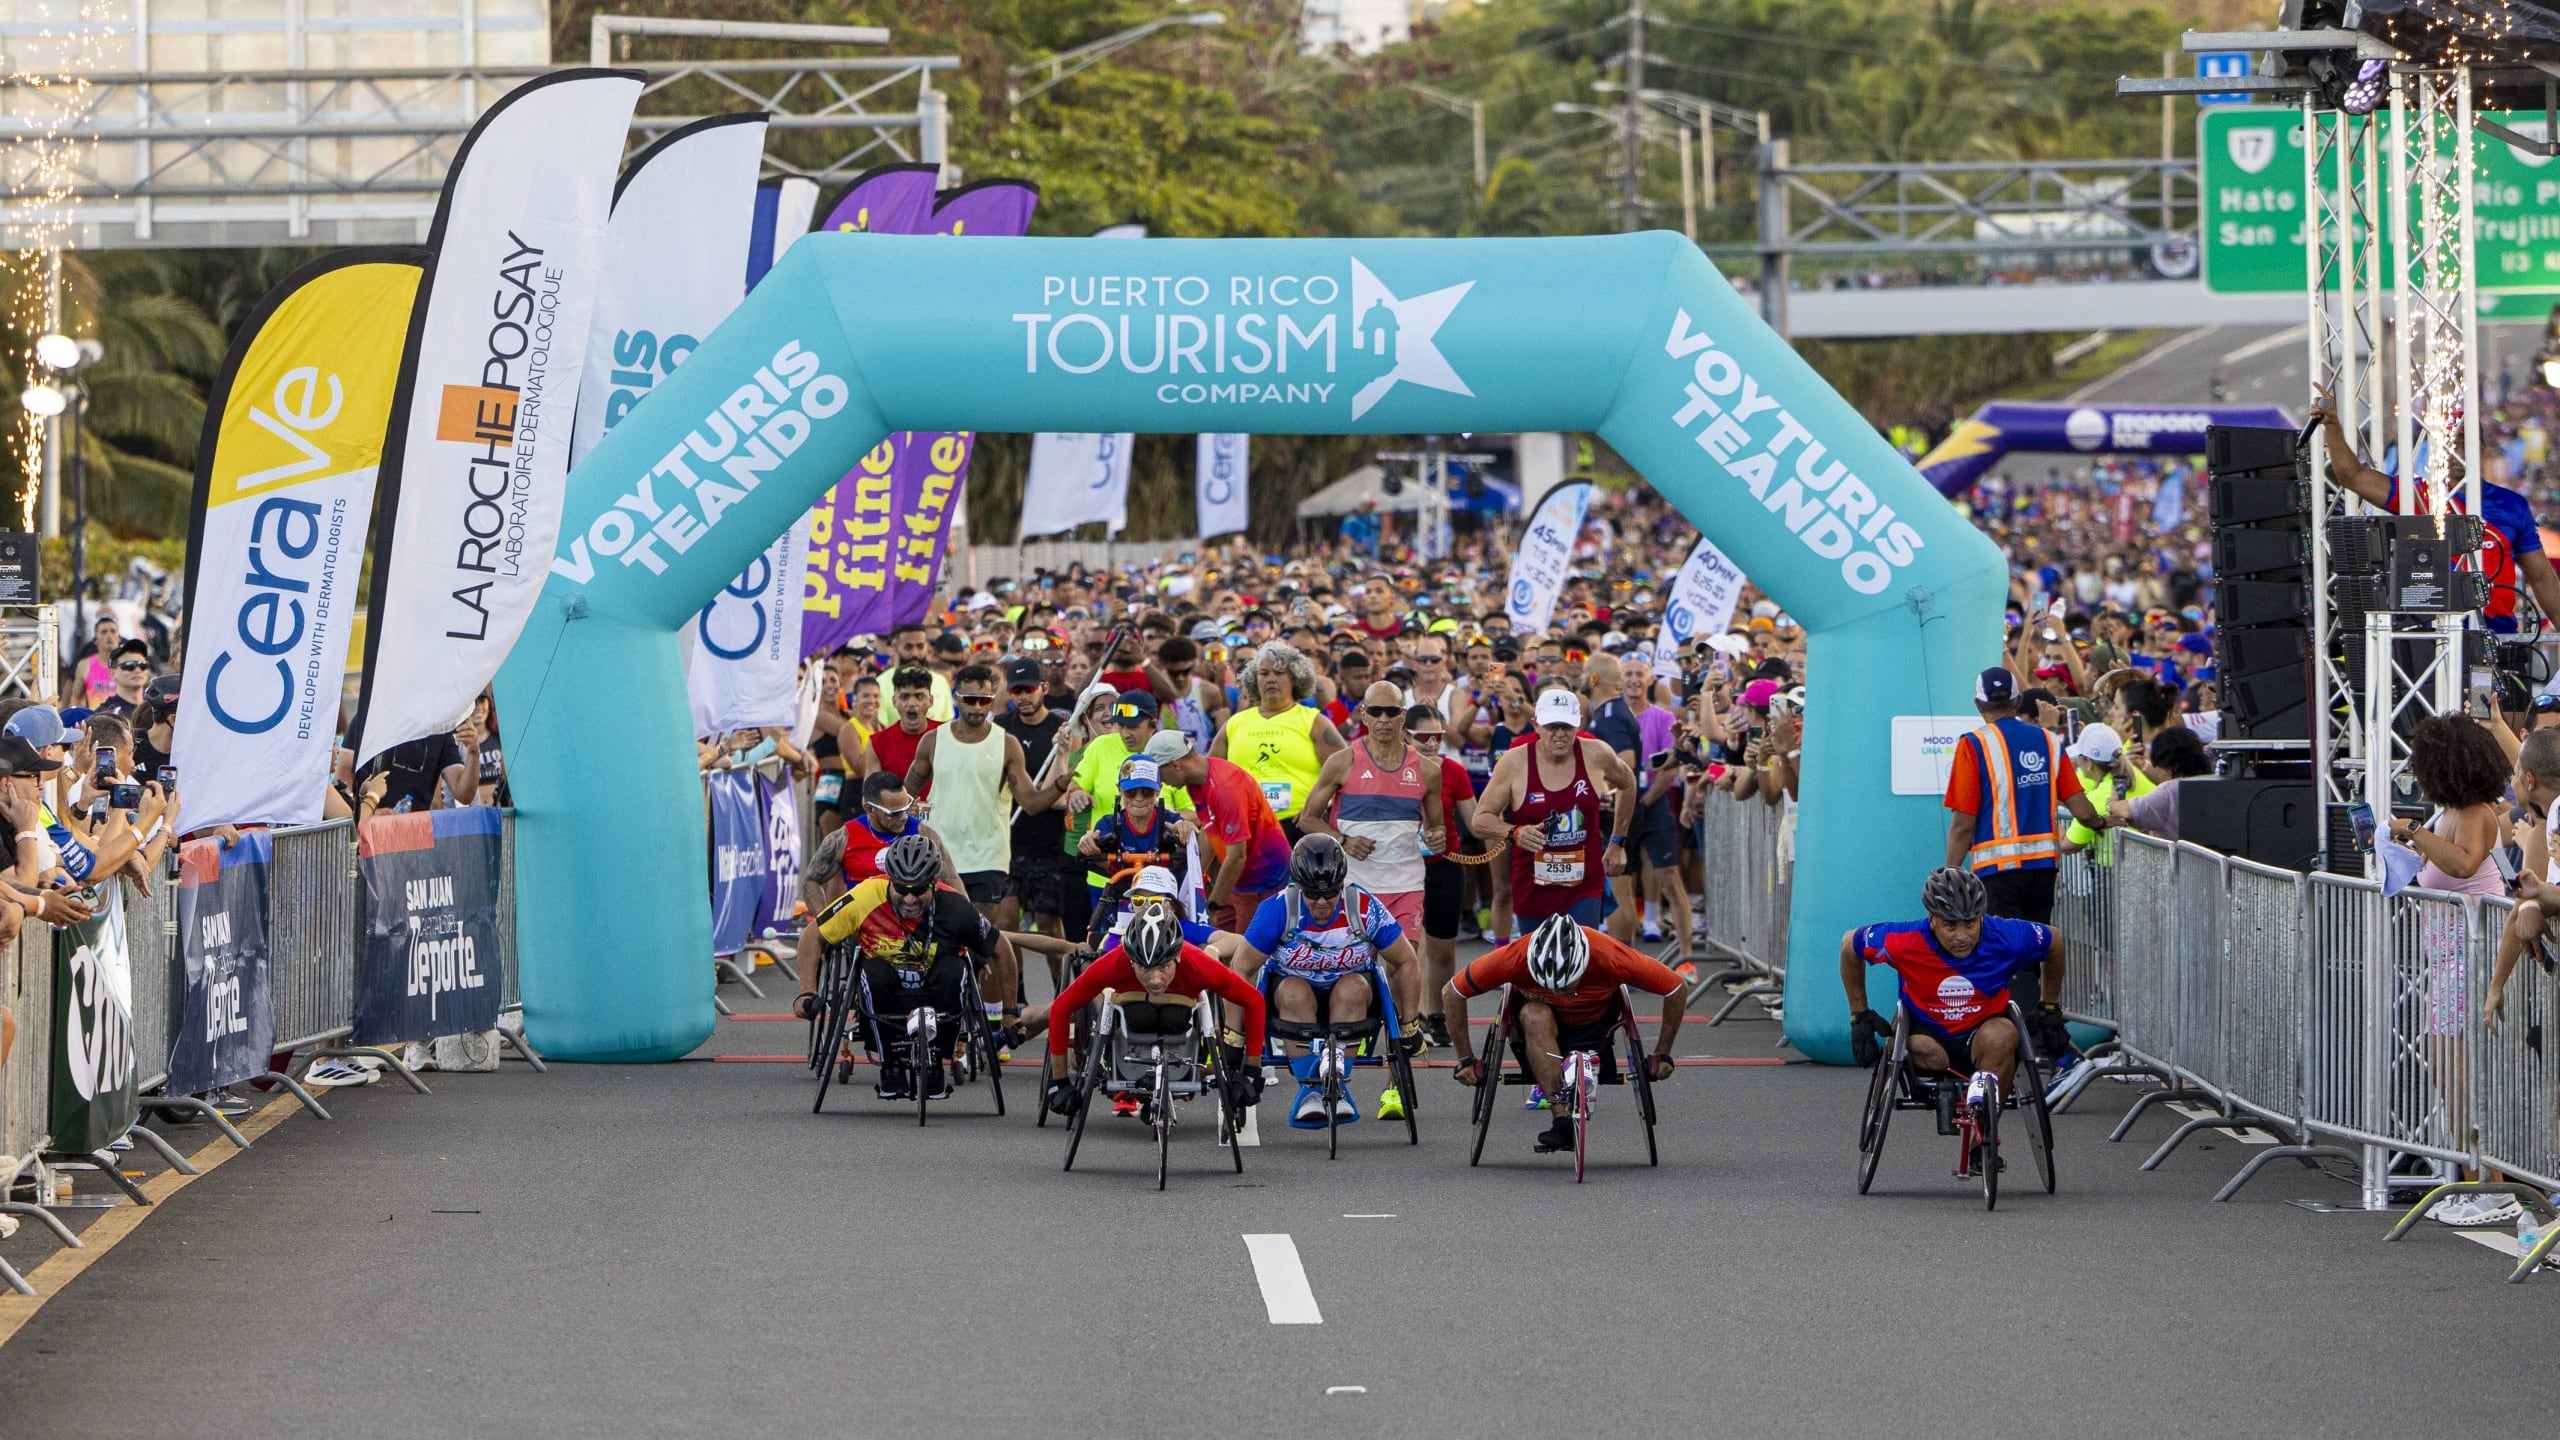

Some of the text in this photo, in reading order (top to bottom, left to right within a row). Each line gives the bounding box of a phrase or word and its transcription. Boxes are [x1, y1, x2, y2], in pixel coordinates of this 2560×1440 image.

[2238, 135, 2264, 162] 17
[2219, 186, 2297, 213] Hato
[2219, 220, 2277, 247] San
[1044, 275, 1339, 306] PUERTO RICO
[1012, 313, 1337, 374] TOURISM
[501, 267, 563, 577] LABORATOIRE DERMATOLOGIQUE
[1156, 382, 1337, 405] COMPANY
[446, 230, 544, 641] LA ROCHE POSAY
[550, 339, 820, 585] VOY TURIS
[1664, 307, 1925, 568] VOY TURIS
[619, 374, 849, 576] TEANDO
[1671, 381, 1892, 595] TEANDO
[205, 366, 344, 735] CeraVe
[775, 570, 786, 598] WITH
[297, 497, 347, 740] DEVELOPED WITH DERMATOLOGISTS
[770, 599, 784, 661] DEVELOPED
[1923, 736, 1953, 745] MOOD
[406, 876, 454, 911] SAN JUAN
[1546, 863, 1572, 874] 2539
[407, 915, 485, 1022] Deporte
[1285, 943, 1367, 970] Puerto Rico
